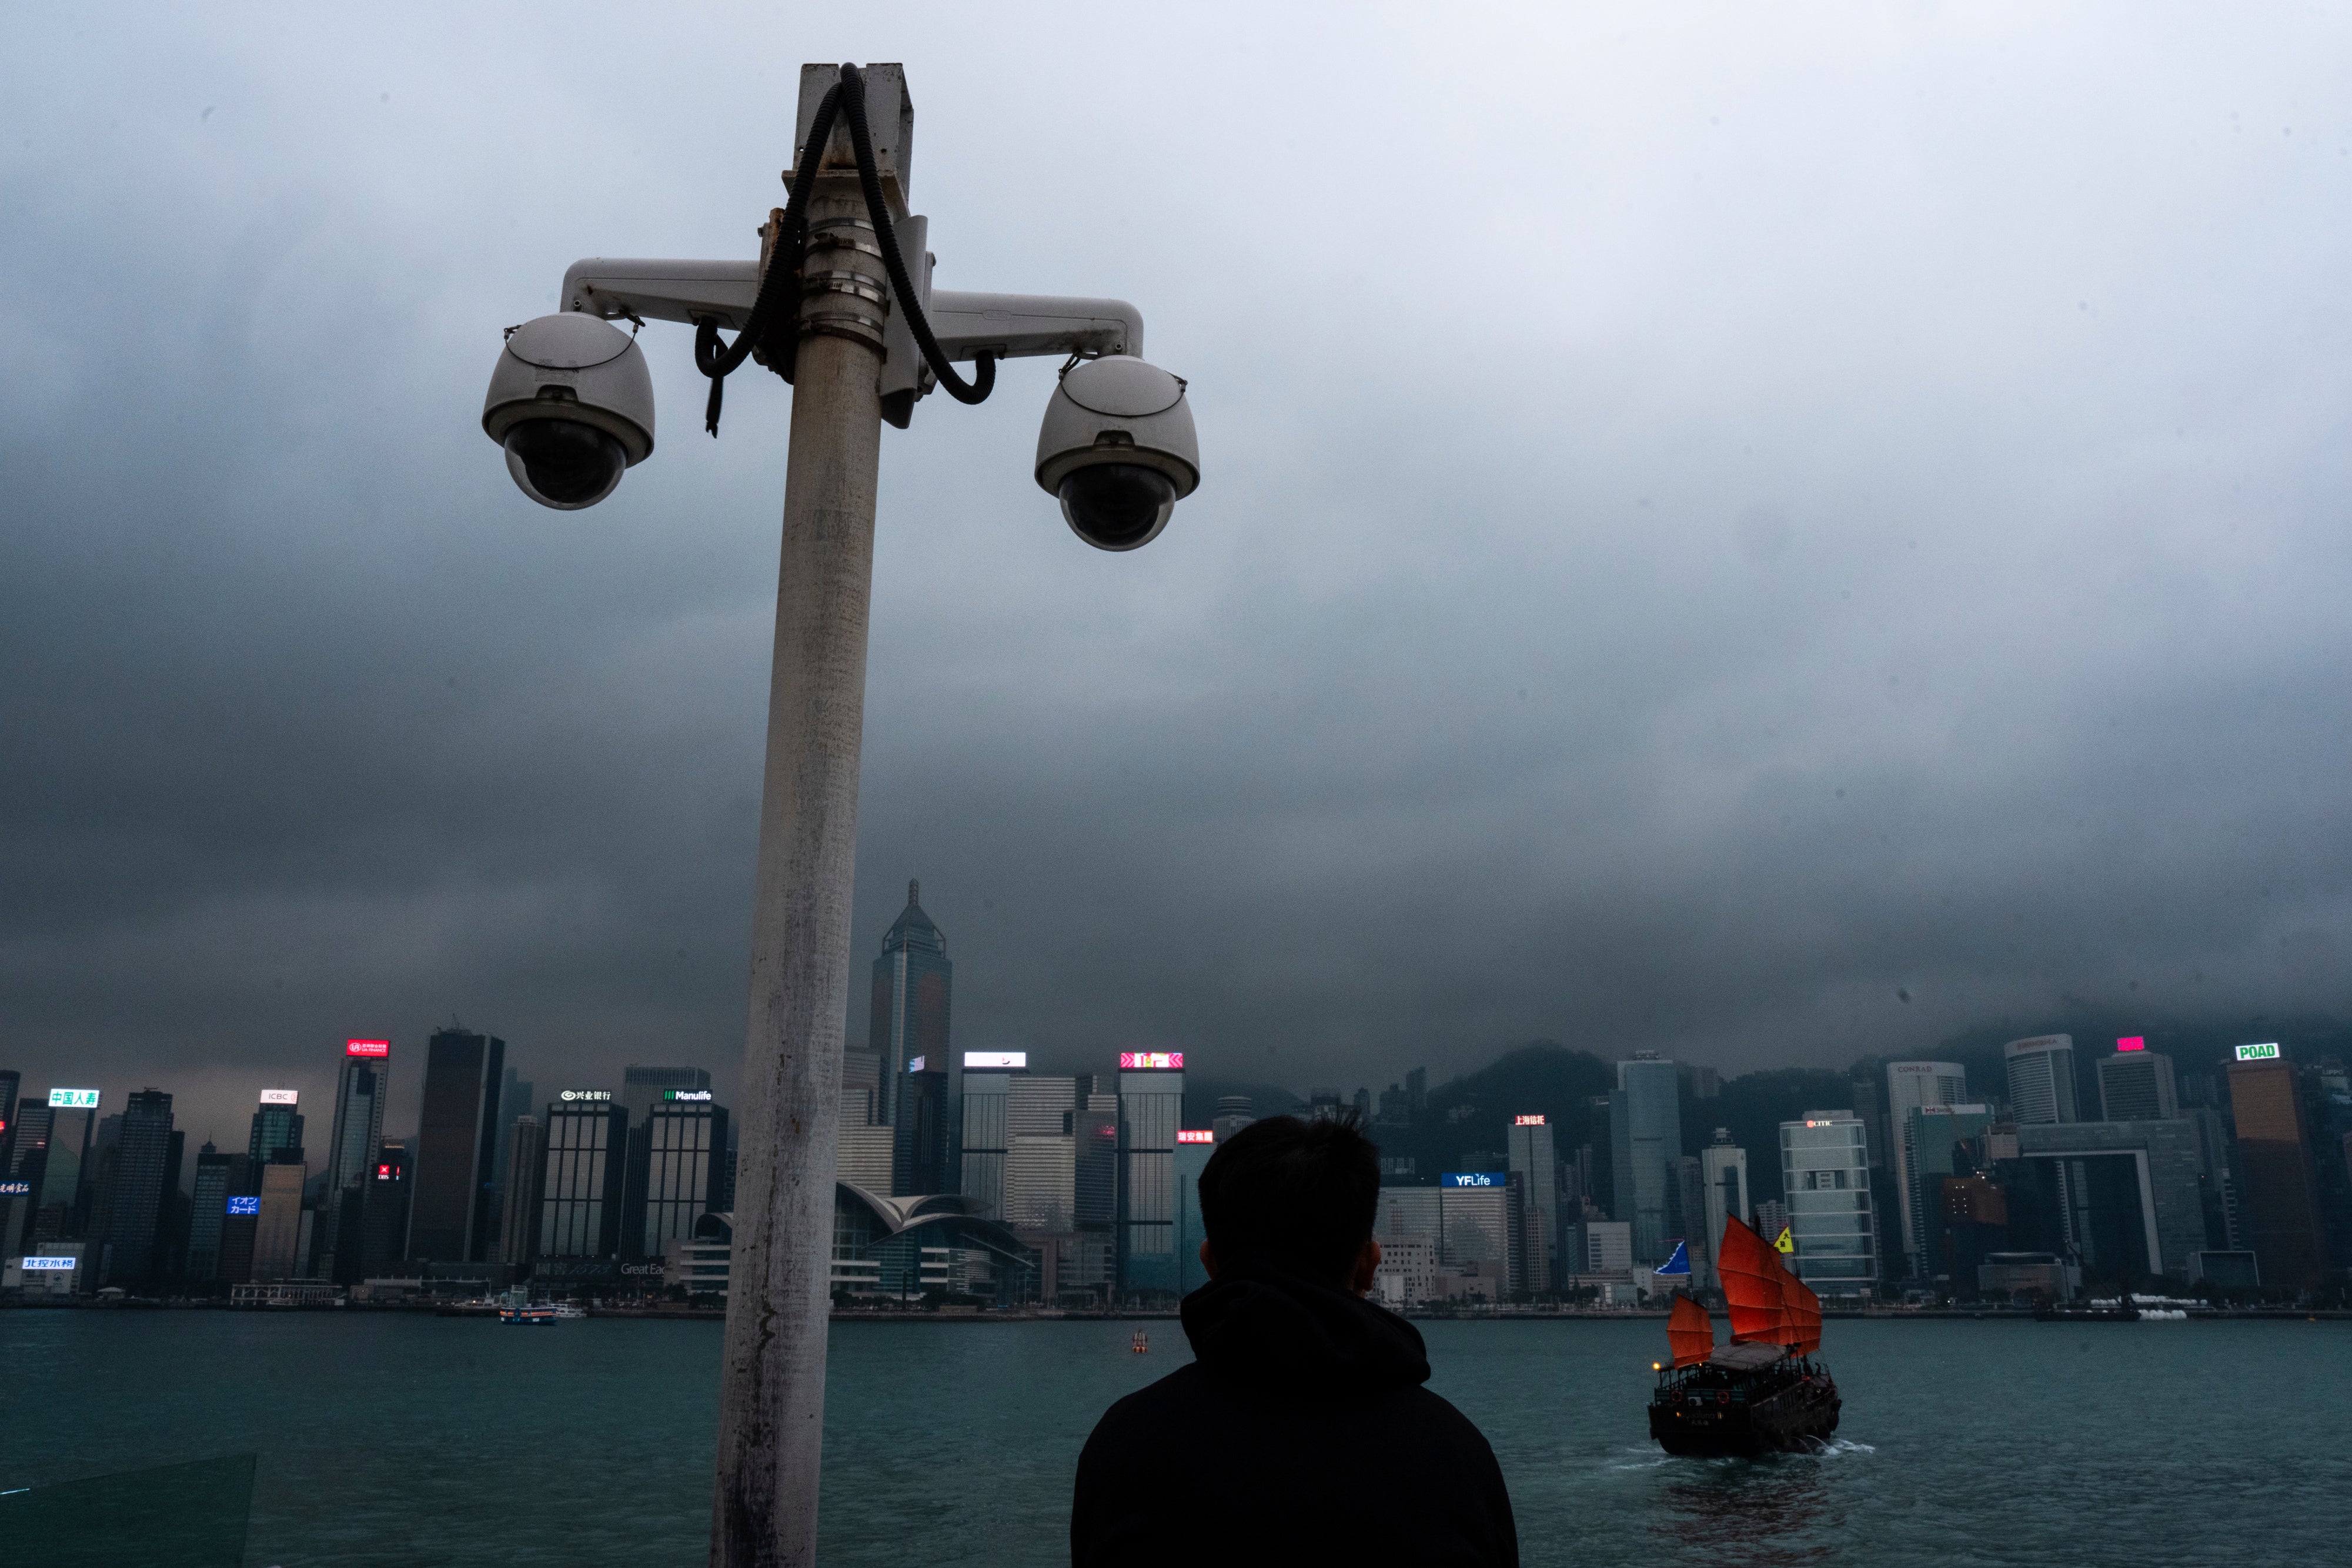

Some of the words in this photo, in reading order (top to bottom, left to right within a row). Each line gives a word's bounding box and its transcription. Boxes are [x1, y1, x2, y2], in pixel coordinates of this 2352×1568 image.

[2240, 1045, 2275, 1059] POAD
[52, 1092, 96, 1105] 中国人寿
[576, 1091, 611, 1100] 兴业银行
[676, 1091, 711, 1100] Manulife
[1515, 1116, 1545, 1125] 上海信托
[1456, 1174, 1491, 1185] YFLife
[0, 1183, 29, 1193] 光明食品
[232, 1197, 258, 1205] イオン
[230, 1206, 256, 1214] カード
[25, 1259, 74, 1268] 北控水務
[621, 1263, 649, 1275] Great
